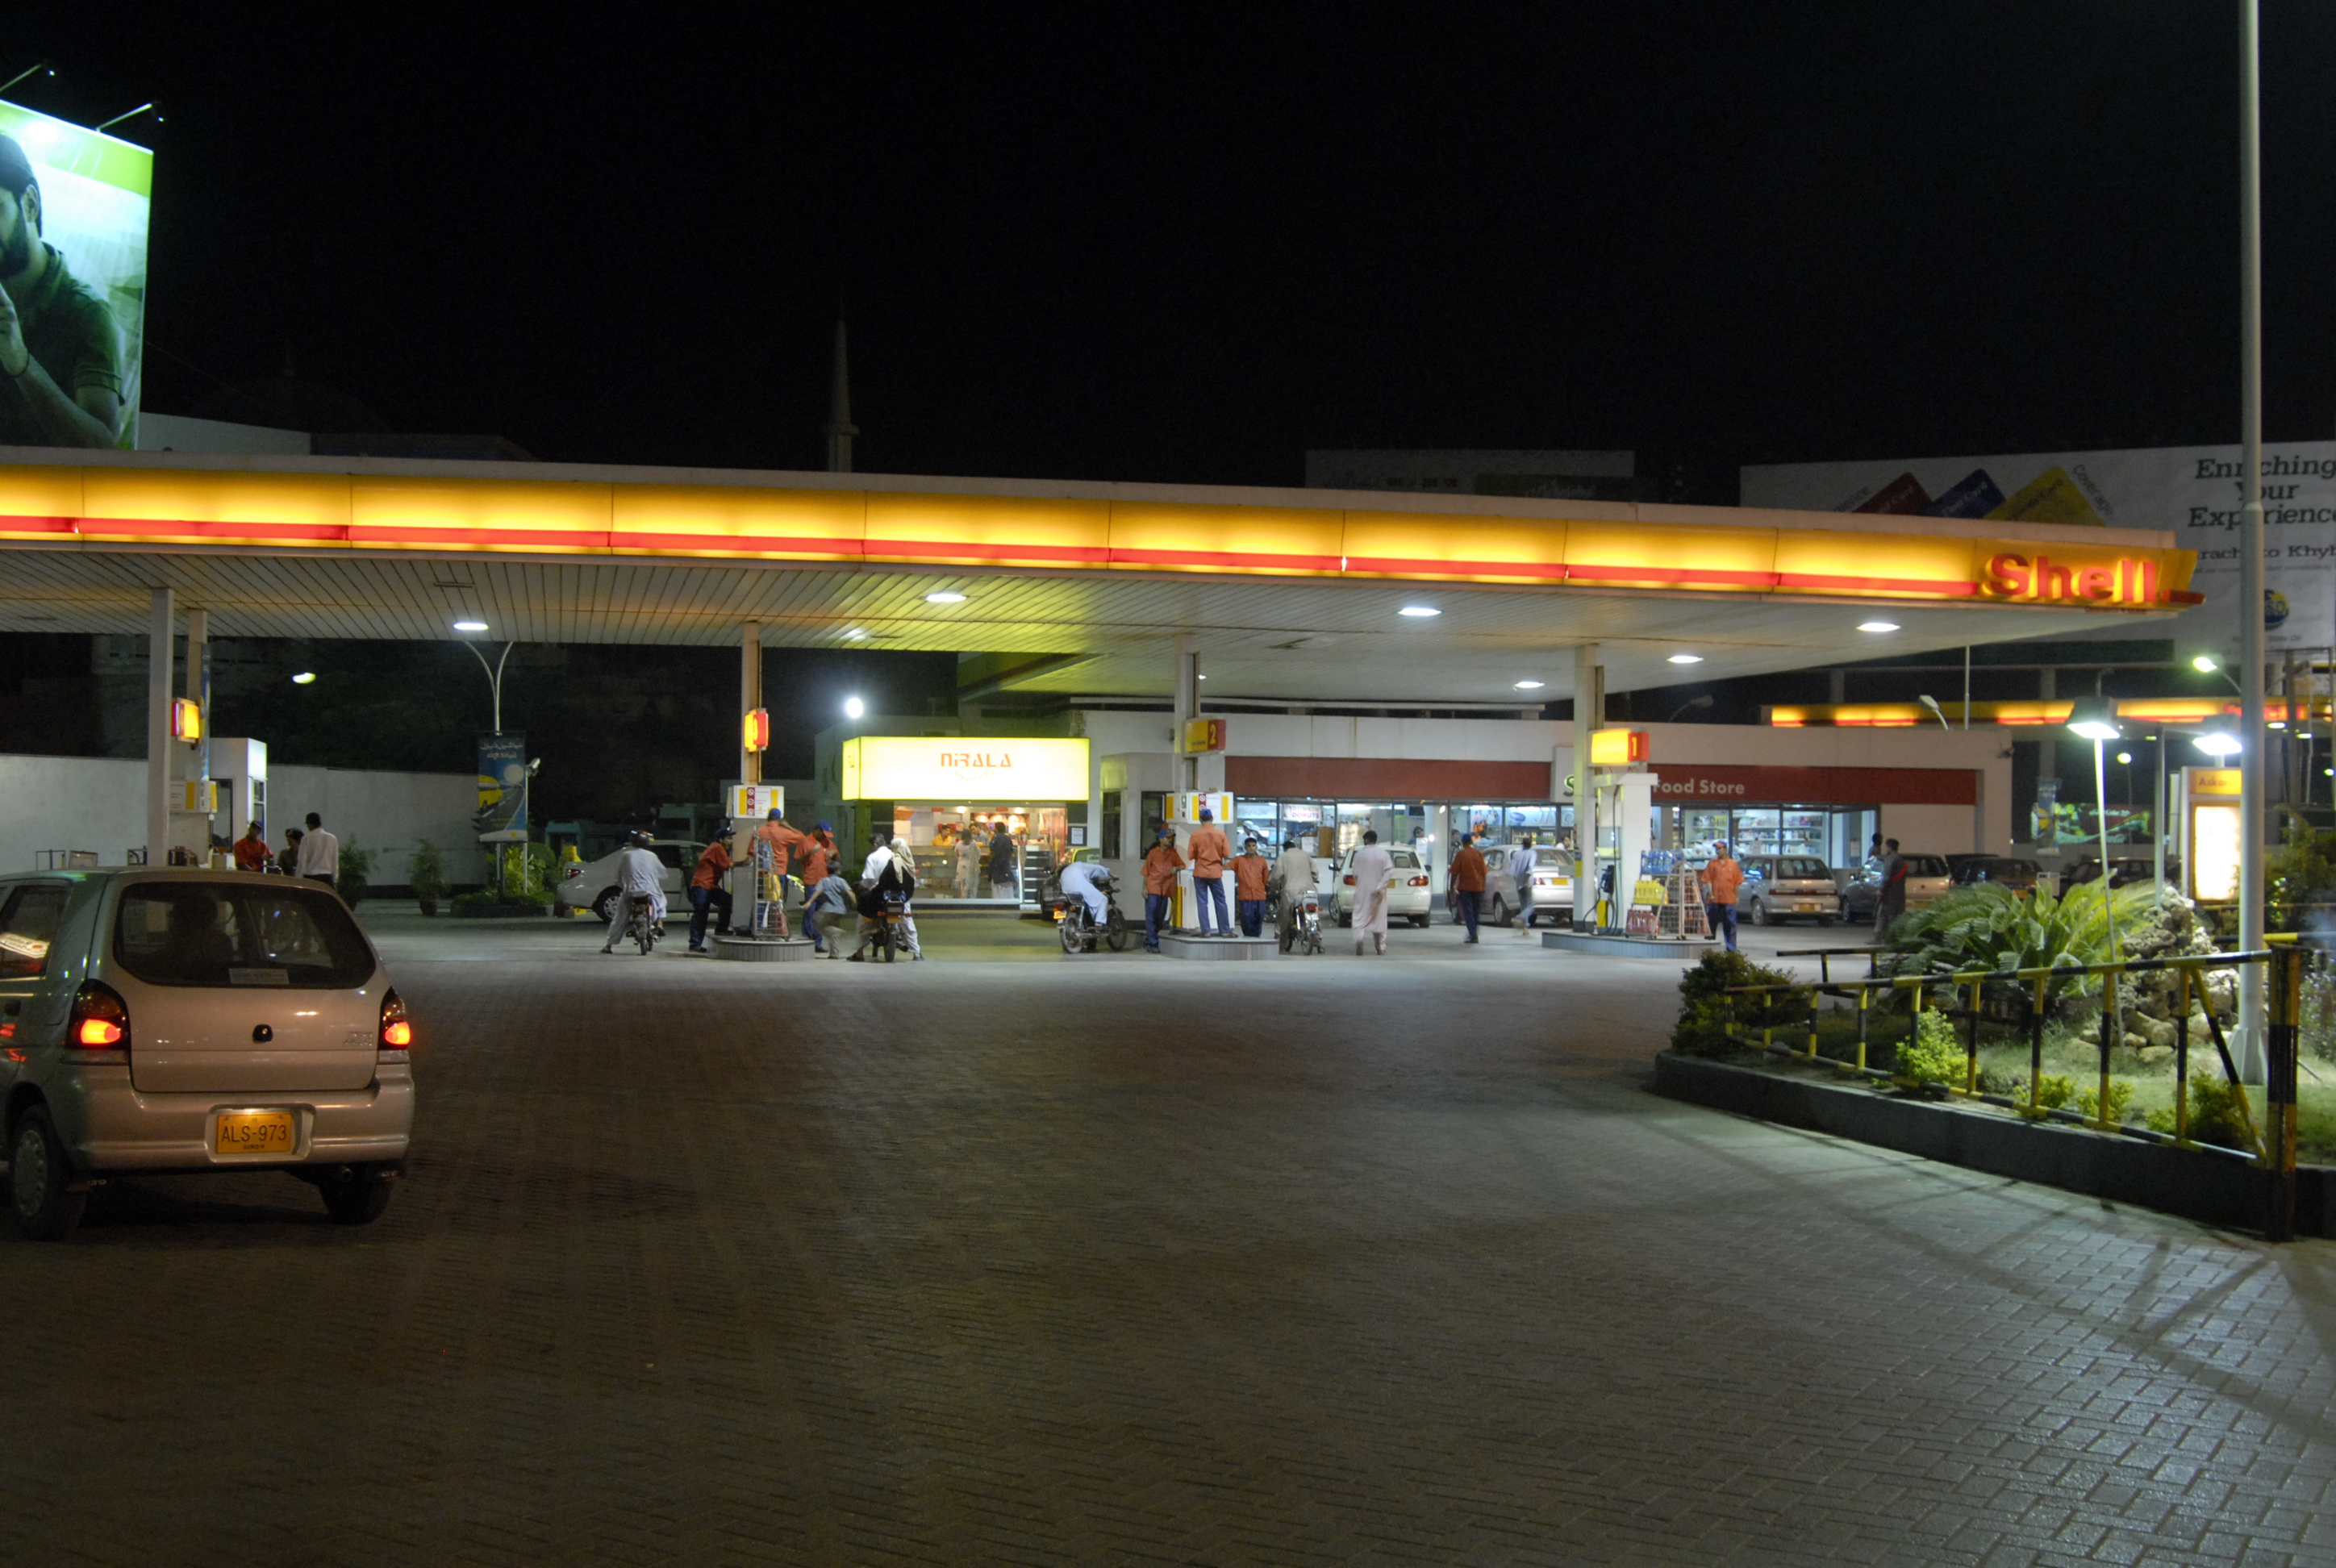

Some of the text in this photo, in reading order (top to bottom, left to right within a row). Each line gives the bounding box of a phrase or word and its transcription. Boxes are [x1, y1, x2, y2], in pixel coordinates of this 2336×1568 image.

[2195, 456, 2336, 479] Enrching
[2073, 463, 2115, 517] Coverage
[2188, 503, 2336, 531] Exprienc
[1989, 553, 2156, 603] Shell
[1210, 724, 1216, 744] 2
[1632, 736, 1637, 757] 1
[1700, 778, 1746, 794] Store
[221, 1124, 286, 1142] ALS-973
